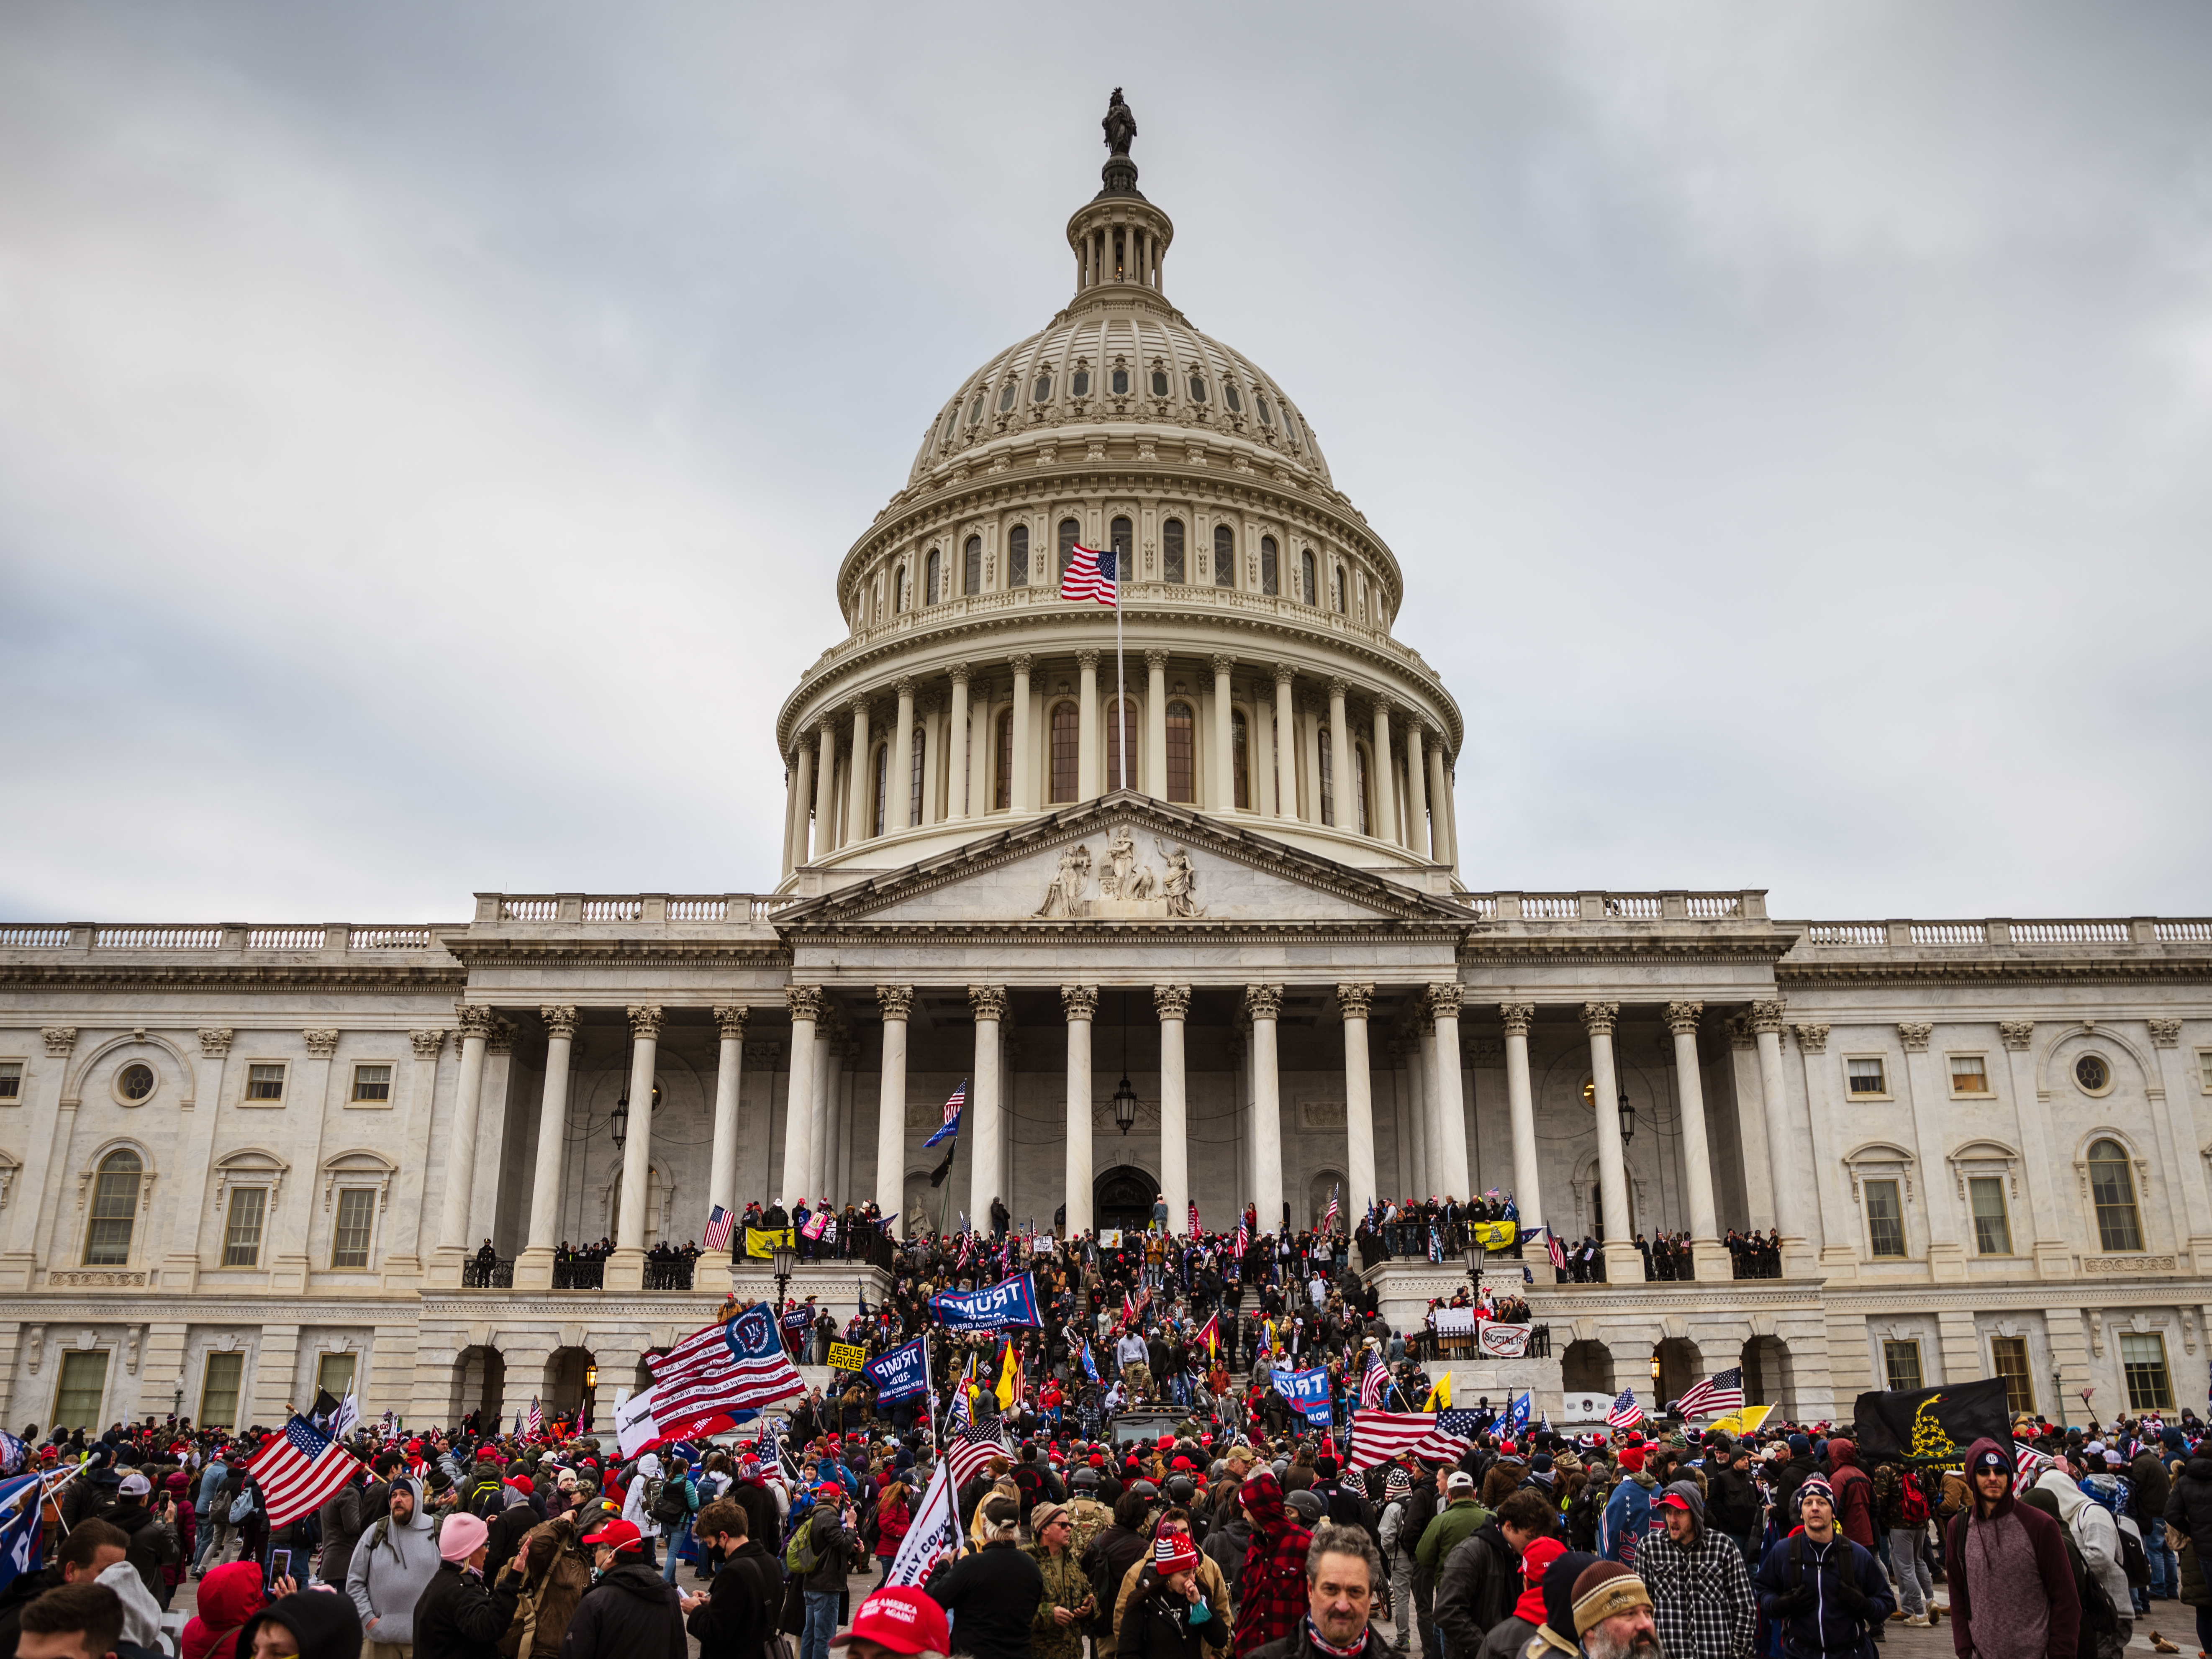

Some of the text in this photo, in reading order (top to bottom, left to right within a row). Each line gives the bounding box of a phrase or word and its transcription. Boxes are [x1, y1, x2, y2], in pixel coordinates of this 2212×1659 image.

[1484, 1332, 1526, 1345] SOCIALIS
[831, 1345, 864, 1359] JESUS
[828, 1354, 862, 1369] SAVES
[878, 1597, 918, 1615] AMERICA
[1602, 1594, 1636, 1611] GUINNESS
[884, 1607, 916, 1624] AGAIN!
